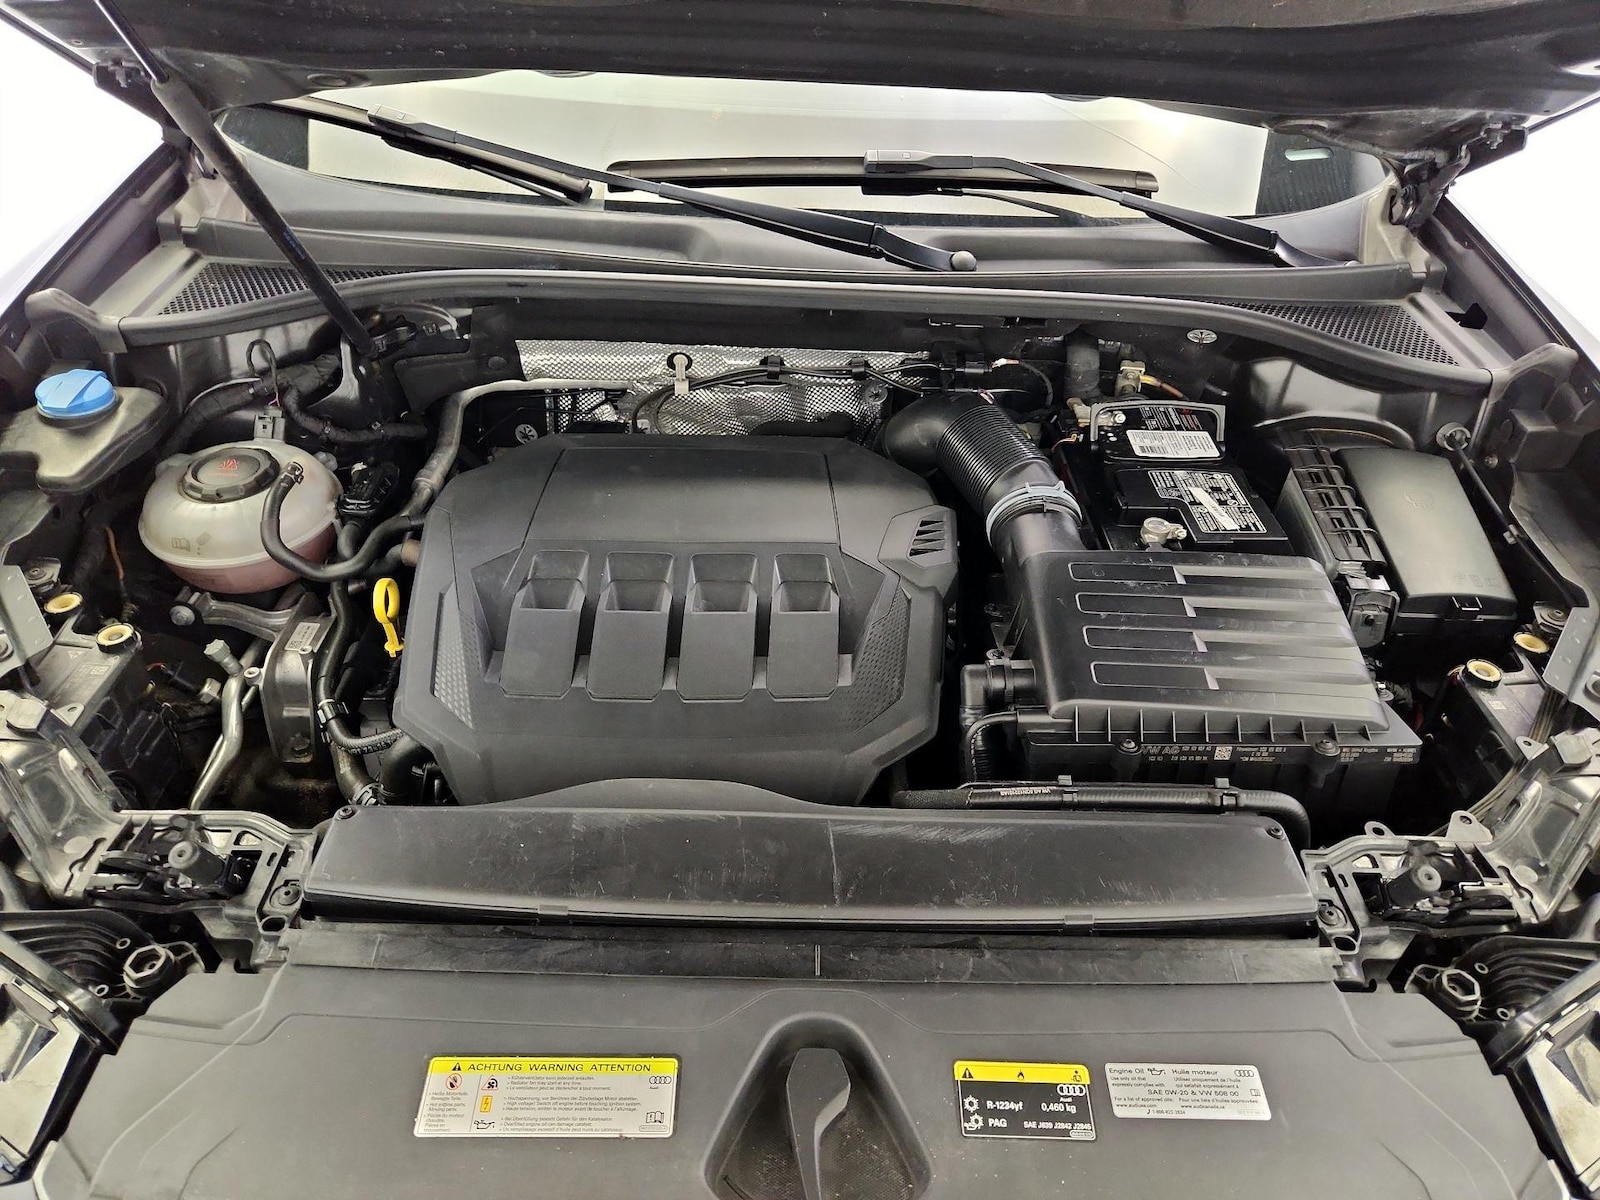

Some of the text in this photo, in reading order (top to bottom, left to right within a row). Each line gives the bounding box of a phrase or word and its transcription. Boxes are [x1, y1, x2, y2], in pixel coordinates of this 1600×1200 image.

[1162, 746, 1180, 754] AG
[467, 1063, 651, 1072] ACHTUNG WARNING ATTENTION
[1109, 1067, 1132, 1075] Engine
[986, 1101, 1023, 1112] R-1234yf
[1041, 1102, 1077, 1114] 0,460 kg
[988, 1118, 1007, 1128] PAG
[1023, 1121, 1037, 1129] SAE
